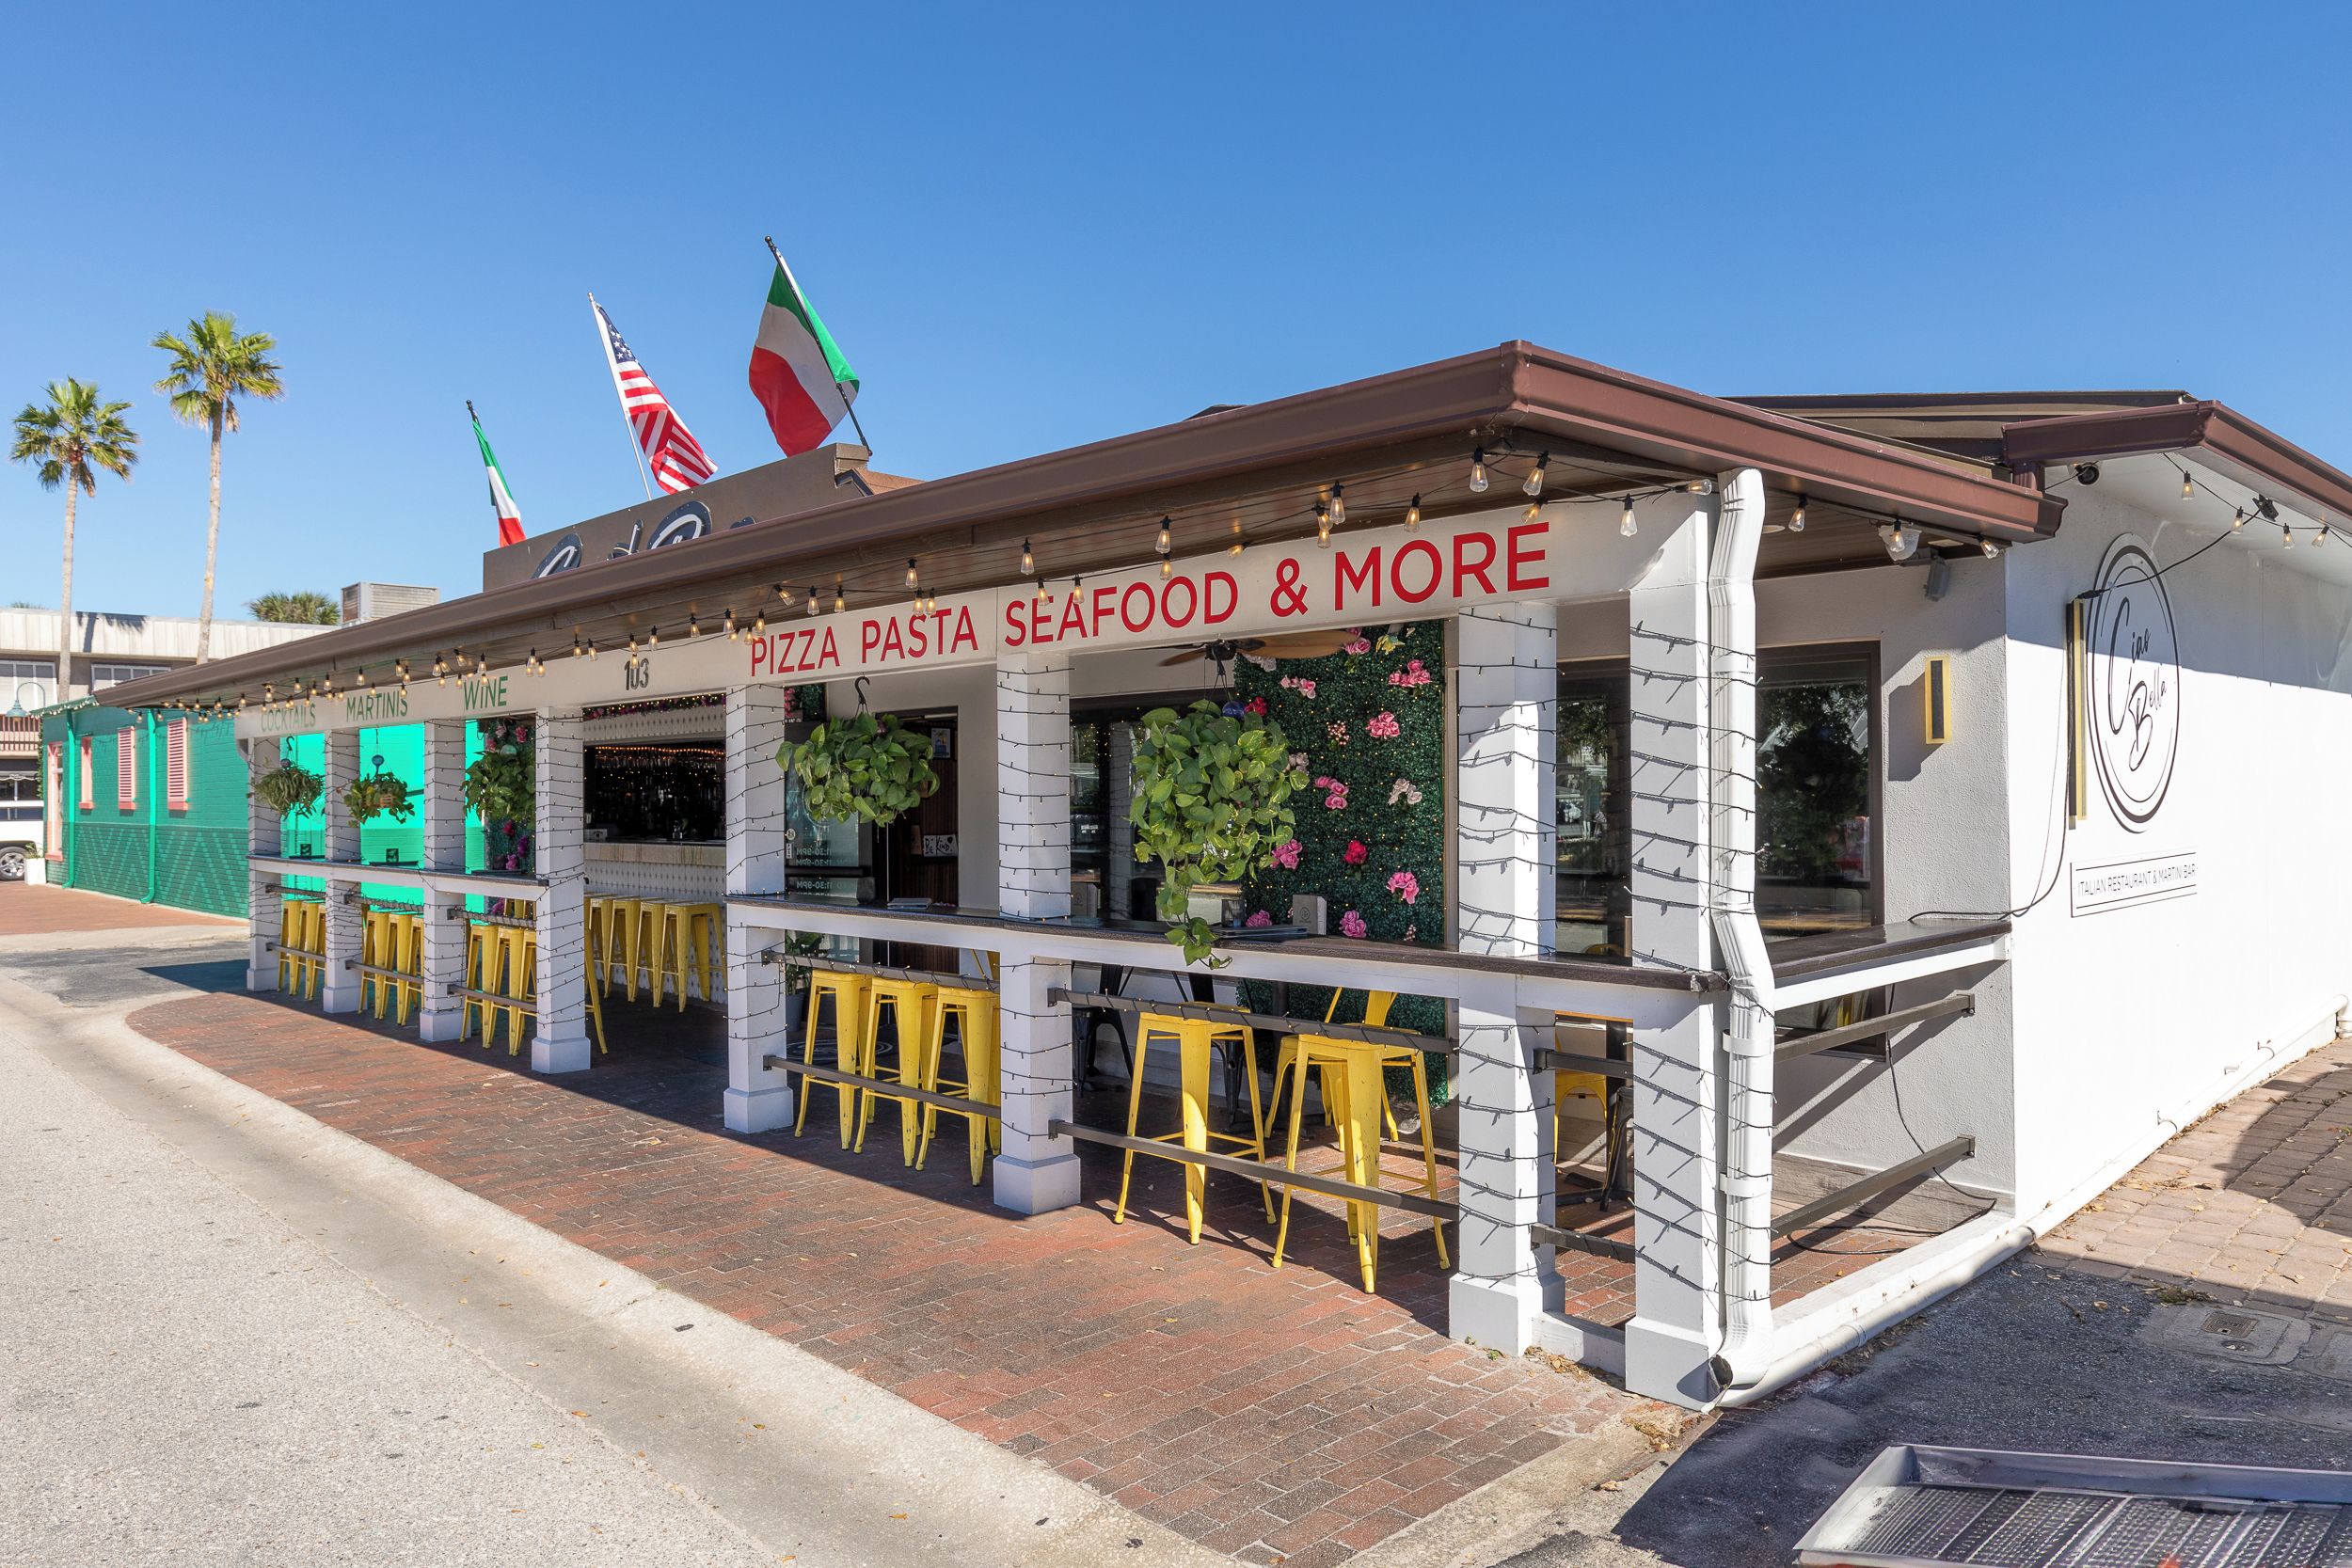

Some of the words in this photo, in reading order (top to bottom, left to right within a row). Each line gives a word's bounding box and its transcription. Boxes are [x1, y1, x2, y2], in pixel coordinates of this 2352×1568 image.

[752, 626, 840, 677] PIZZA
[862, 605, 978, 663] PASTA
[1005, 571, 1238, 647] SEAFOOD
[1270, 558, 1309, 617] &
[1335, 522, 1549, 611] MORE
[261, 703, 316, 732] COCKTAILS
[346, 690, 407, 722] MARTINIS
[464, 675, 508, 710] WINE
[624, 657, 649, 690] 103
[2108, 596, 2151, 735] Ciao
[2128, 663, 2167, 771] Bella
[2077, 879, 2106, 896] ITALIAN
[2108, 871, 2152, 893] RESTAURANT
[2153, 870, 2157, 884] &
[2158, 866, 2182, 882] MARTINI
[2184, 863, 2196, 879] BAR
